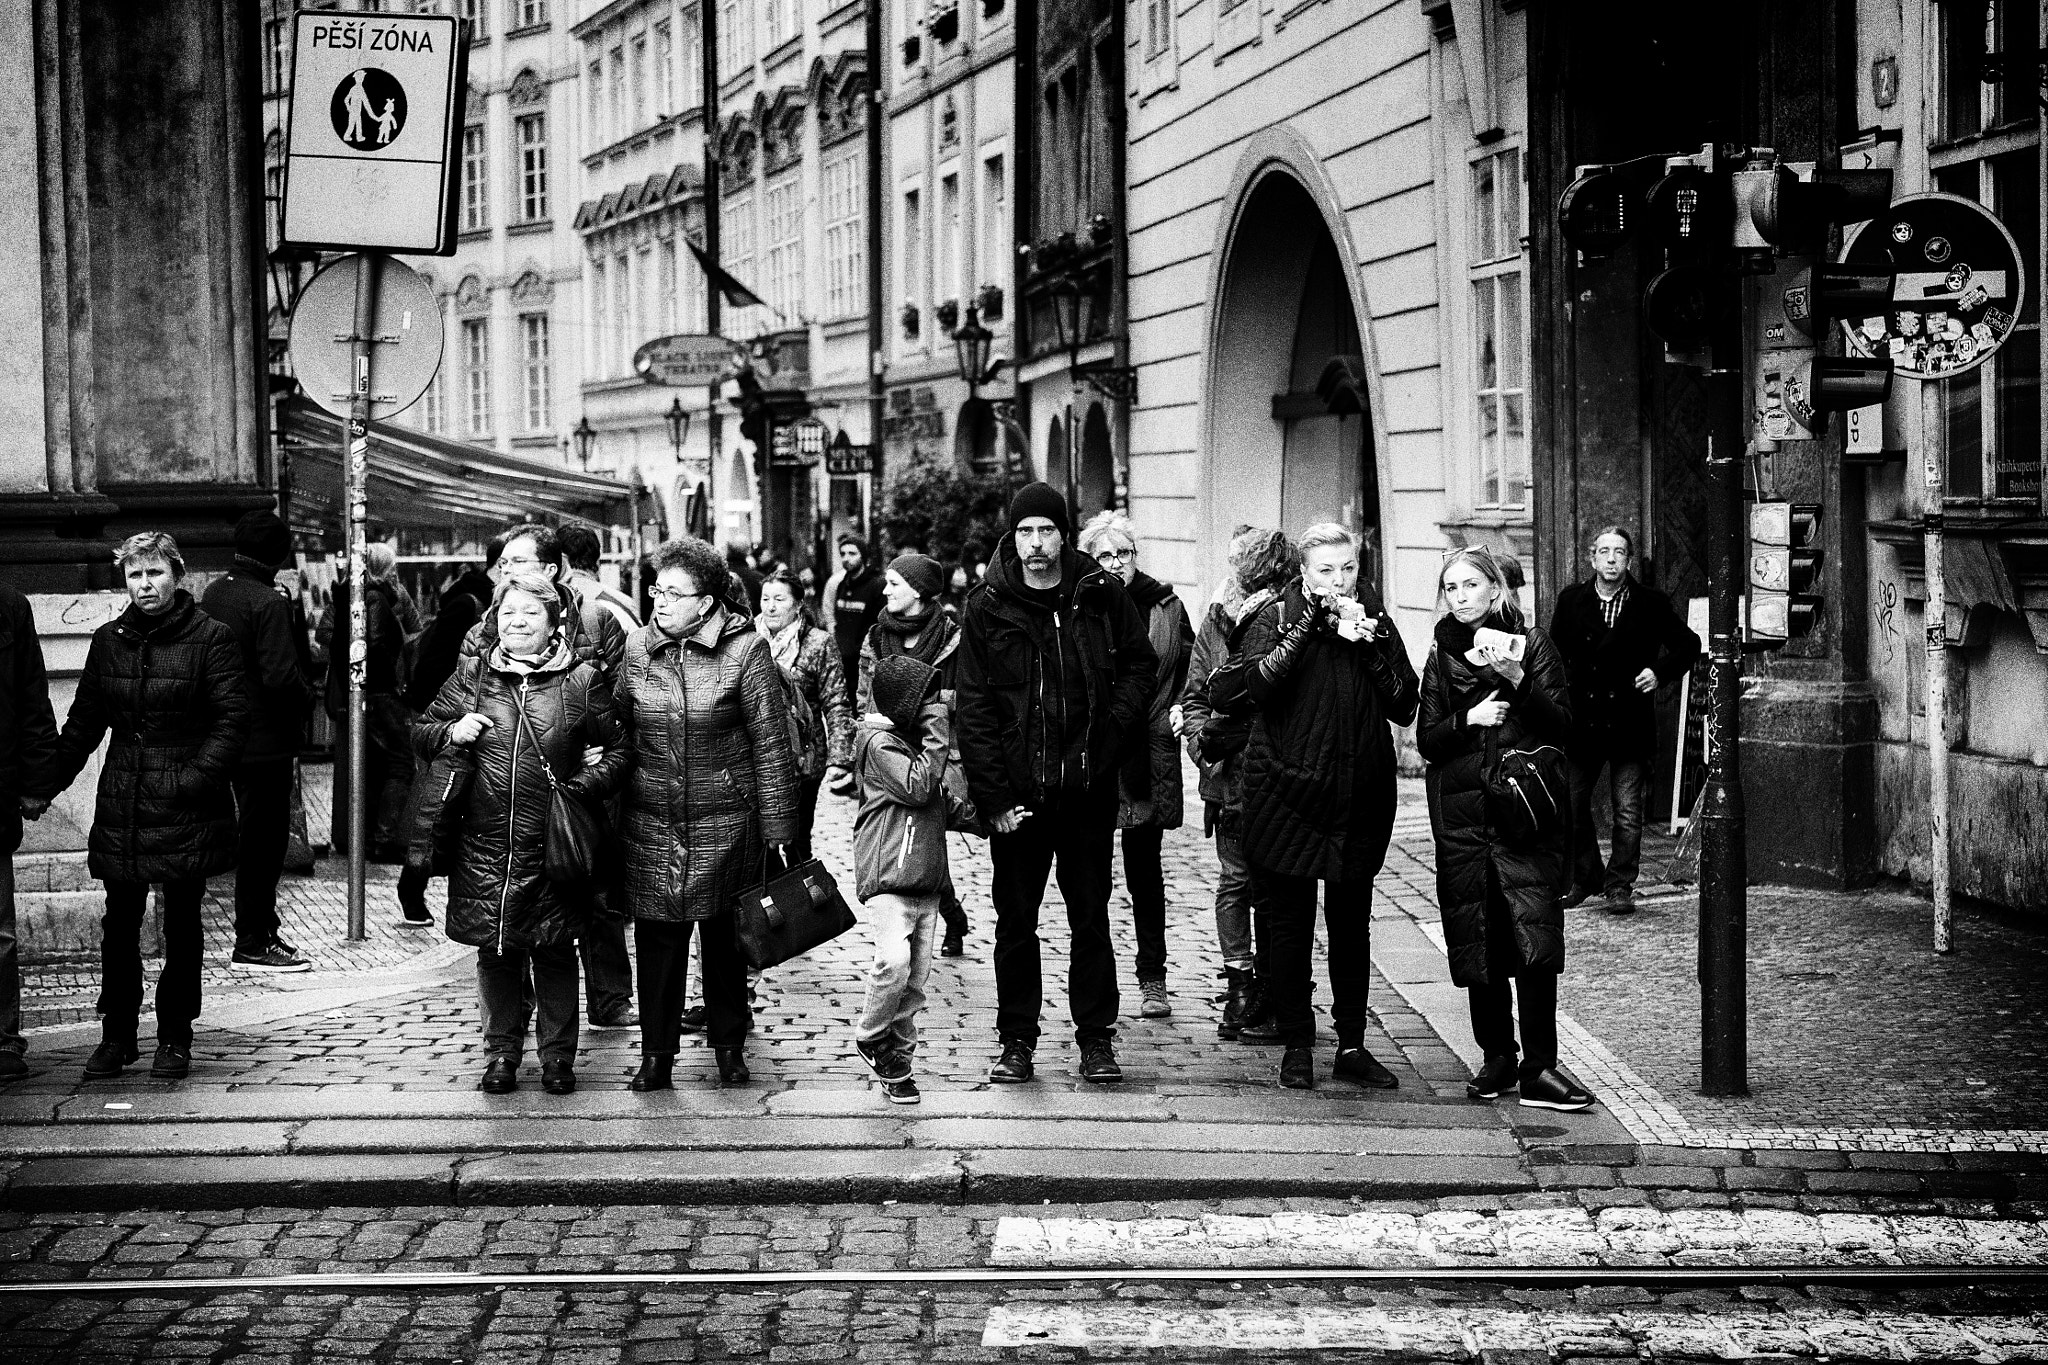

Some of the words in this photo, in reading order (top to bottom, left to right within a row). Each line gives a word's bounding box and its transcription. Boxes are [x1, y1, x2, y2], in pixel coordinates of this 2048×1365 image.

[313, 20, 366, 50] PĚŠÍ
[370, 23, 433, 53] ZÓNA
[828, 459, 874, 472] CLUB
